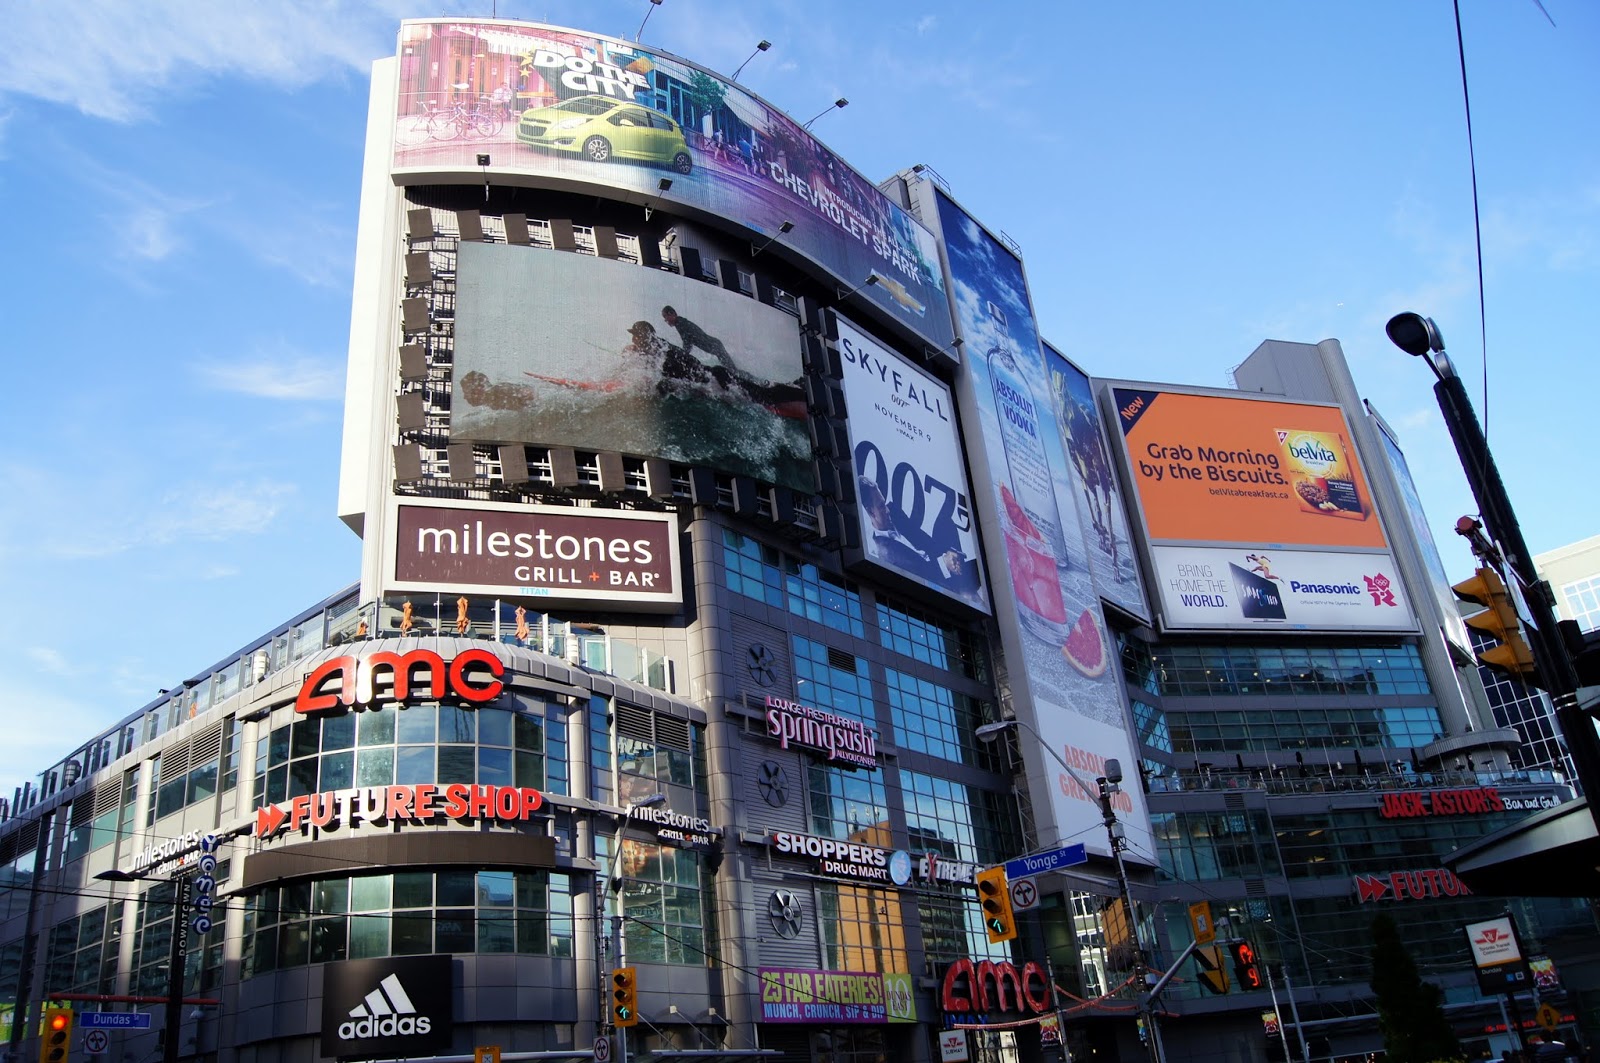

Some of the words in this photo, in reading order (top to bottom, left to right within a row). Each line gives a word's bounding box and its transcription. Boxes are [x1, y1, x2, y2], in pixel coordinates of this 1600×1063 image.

[532, 49, 593, 74] DO
[595, 62, 651, 89] THE
[561, 70, 636, 99] CITY
[769, 161, 869, 246] CHEVROLET
[872, 234, 922, 286] SPARK
[823, 185, 873, 230] INTRODUCING
[874, 222, 887, 243] THE
[887, 235, 918, 265] ALL-NEW
[842, 338, 949, 422] SKYFALL
[996, 378, 1034, 418] ABSOLUT
[1120, 396, 1145, 421] New
[874, 403, 924, 438] NOVEMBER
[926, 434, 932, 442] 9
[1003, 402, 1037, 439] VODKA
[1147, 443, 1193, 462] Grab
[1198, 446, 1279, 470] Morning
[1288, 441, 1337, 463] belVita
[1139, 460, 1163, 481] by
[1169, 463, 1202, 480] the
[1207, 465, 1289, 485] Biscuits.
[1209, 487, 1289, 499] belVitabreakfast.ca
[418, 520, 653, 565] milestones
[514, 566, 582, 584] GRILL
[1177, 564, 1213, 577] BRING
[520, 587, 549, 595] TITAN
[1169, 579, 1205, 593] HOME
[1205, 580, 1228, 593] THE
[1290, 580, 1361, 595] Panasonic
[1181, 594, 1228, 607] WORLD.
[765, 695, 803, 715] LOUNGE
[1064, 744, 1107, 777] ABSOLU
[291, 784, 436, 831] FUTURE
[445, 783, 543, 821] SHOP
[1059, 773, 1133, 814] GREHUND
[1380, 793, 1429, 818] JACK
[1430, 787, 1505, 816] ASTOR'S
[1502, 798, 1523, 810] Bar
[1524, 797, 1540, 809] and
[132, 828, 200, 871] milestones
[660, 829, 686, 841] GRILL
[692, 834, 710, 845] BAR
[774, 832, 887, 867] SHOPPERS
[157, 857, 180, 875] GRILL
[824, 860, 857, 875] DRUG
[858, 865, 888, 880] MART
[918, 852, 974, 887] EXTREME
[1024, 855, 1058, 871] Yonge
[1060, 850, 1067, 858] St
[1481, 967, 1503, 975] Dundas
[762, 971, 782, 1003] 25
[784, 972, 813, 1003] FAB
[814, 973, 884, 1005] EATERIES!
[93, 1013, 131, 1025] Dundas
[763, 1003, 803, 1020] MUNCH,
[804, 1004, 844, 1020] CRUNCH,
[863, 1005, 869, 1019] &
[338, 1013, 431, 1041] adidas
